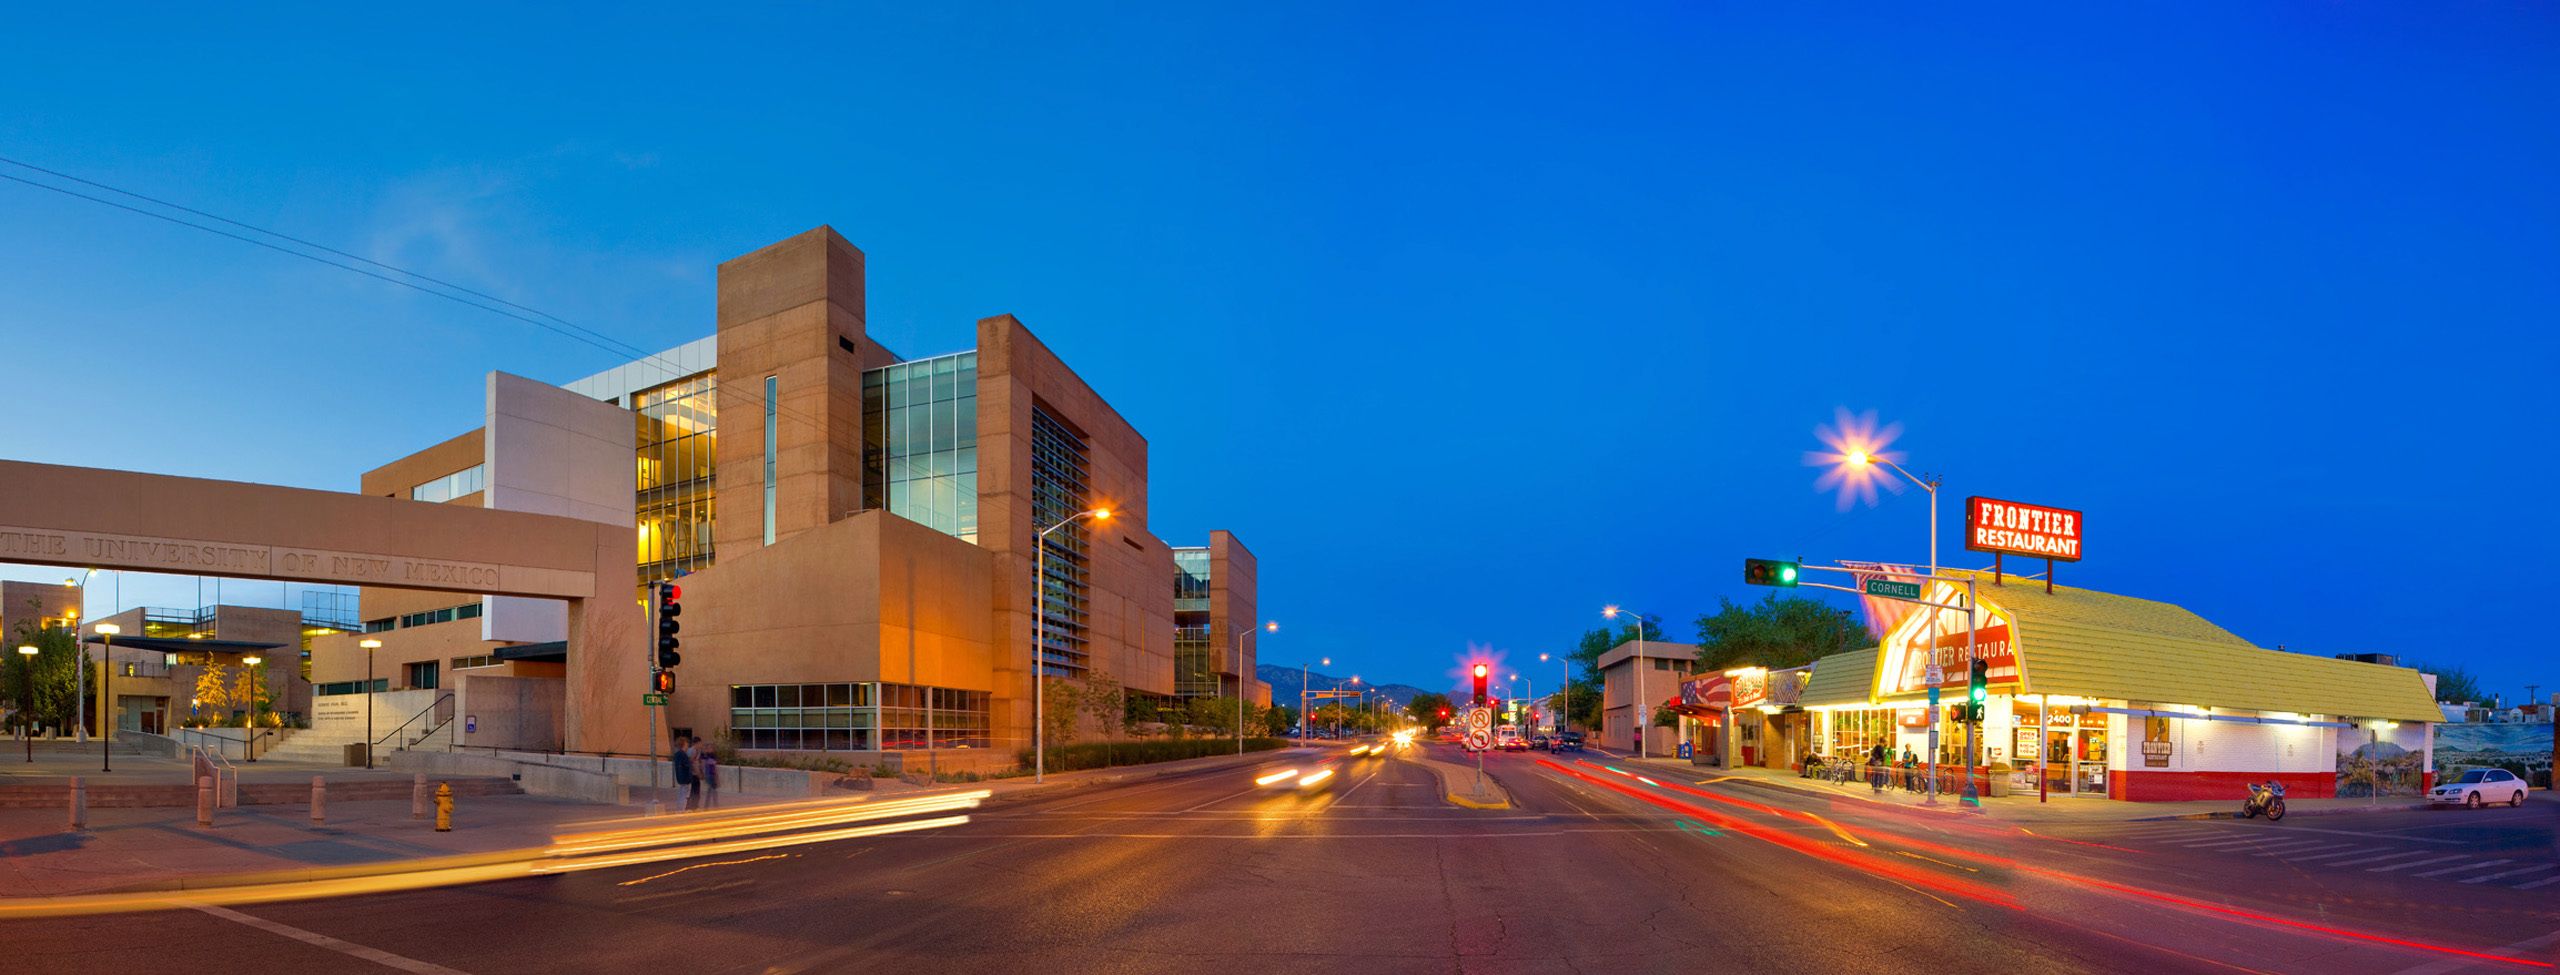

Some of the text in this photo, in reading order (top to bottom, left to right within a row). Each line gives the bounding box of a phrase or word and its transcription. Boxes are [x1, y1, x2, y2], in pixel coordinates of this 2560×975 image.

[1981, 502, 2075, 536] FRONTIER
[1977, 527, 2078, 555] RESTAURANT
[1, 532, 499, 587] THE UNIVERSITY OF NEW MEXICO
[1870, 582, 1917, 597] CORNELL
[2047, 714, 2072, 725] 2400
